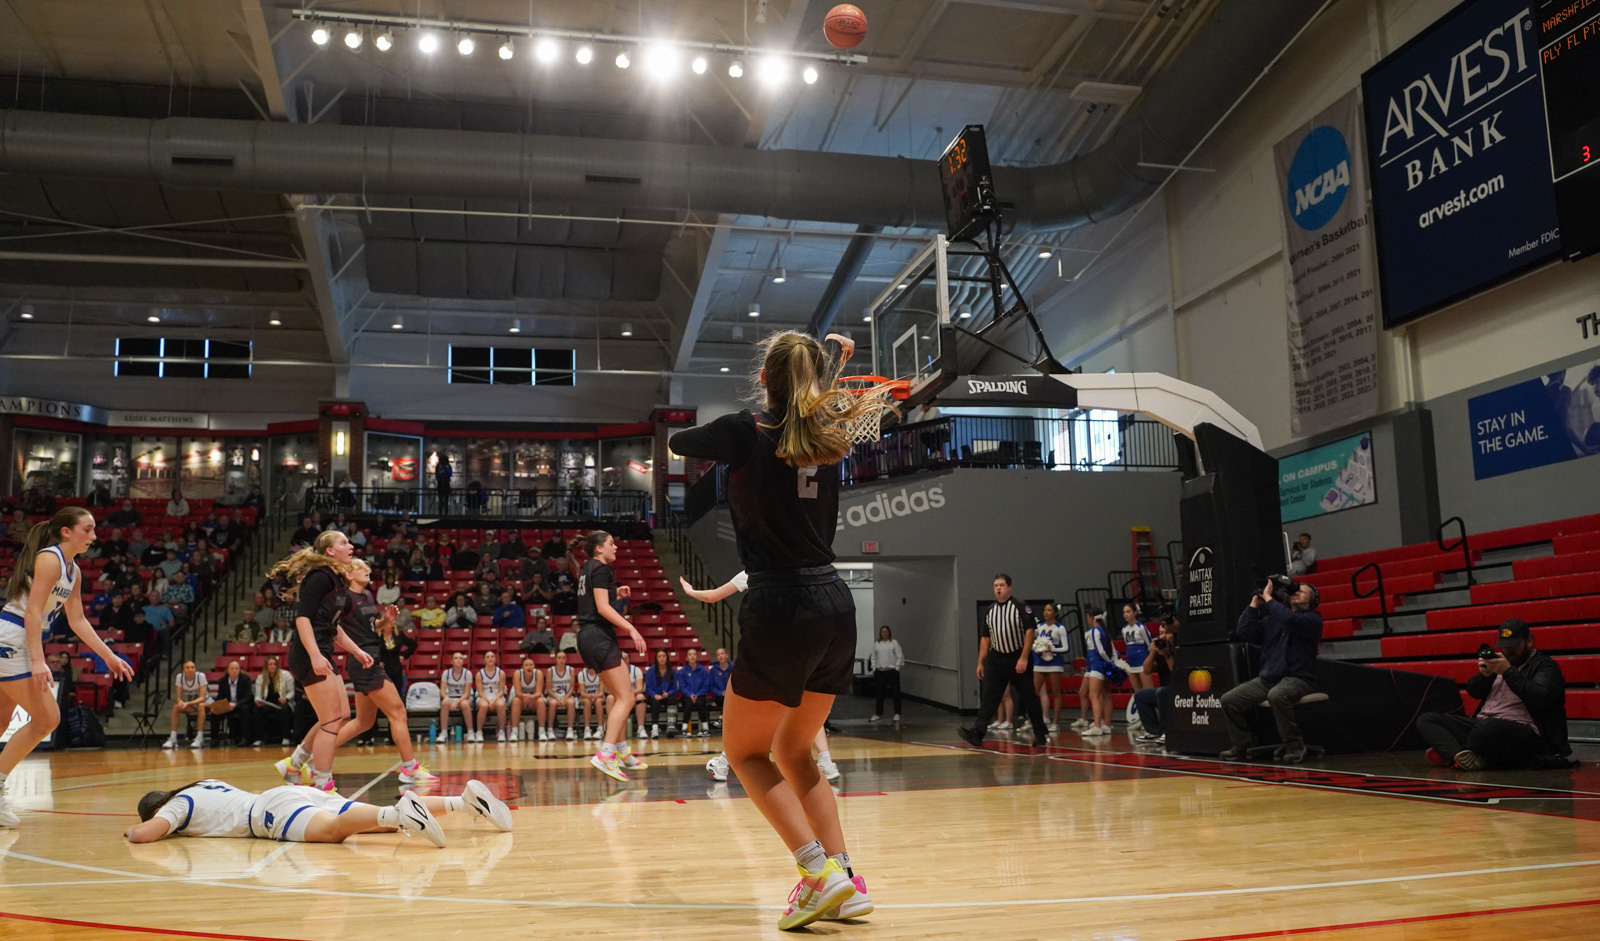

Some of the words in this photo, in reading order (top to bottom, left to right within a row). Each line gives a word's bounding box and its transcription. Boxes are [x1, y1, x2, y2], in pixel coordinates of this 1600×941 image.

[1543, 42, 1561, 65] PLY
[1567, 33, 1580, 50] FL
[1404, 110, 1506, 191] BANK
[1582, 145, 1590, 162] 3
[1295, 159, 1350, 216] NCAA
[1418, 173, 1505, 229] arvest.com
[1508, 237, 1539, 258] Member
[1540, 227, 1561, 245] FDIC
[968, 379, 1029, 396] SPALDING
[150, 415, 194, 424] MATTHEWS
[1477, 414, 1507, 436] STAY
[1510, 409, 1526, 428] IN
[1477, 435, 1504, 455] THE
[1504, 425, 1550, 448] GAME.
[1282, 473, 1296, 483] ON
[1297, 460, 1338, 479] CAMPUS
[1310, 476, 1333, 489] Students
[846, 485, 946, 528] adidas
[1189, 567, 1213, 583] MATTAX
[1201, 580, 1213, 593] NEU
[1189, 592, 1213, 608] PRATER
[1126, 631, 1136, 643] M
[556, 686, 568, 695] 24
[1174, 694, 1194, 708] Great
[1191, 710, 1210, 726] Bank
